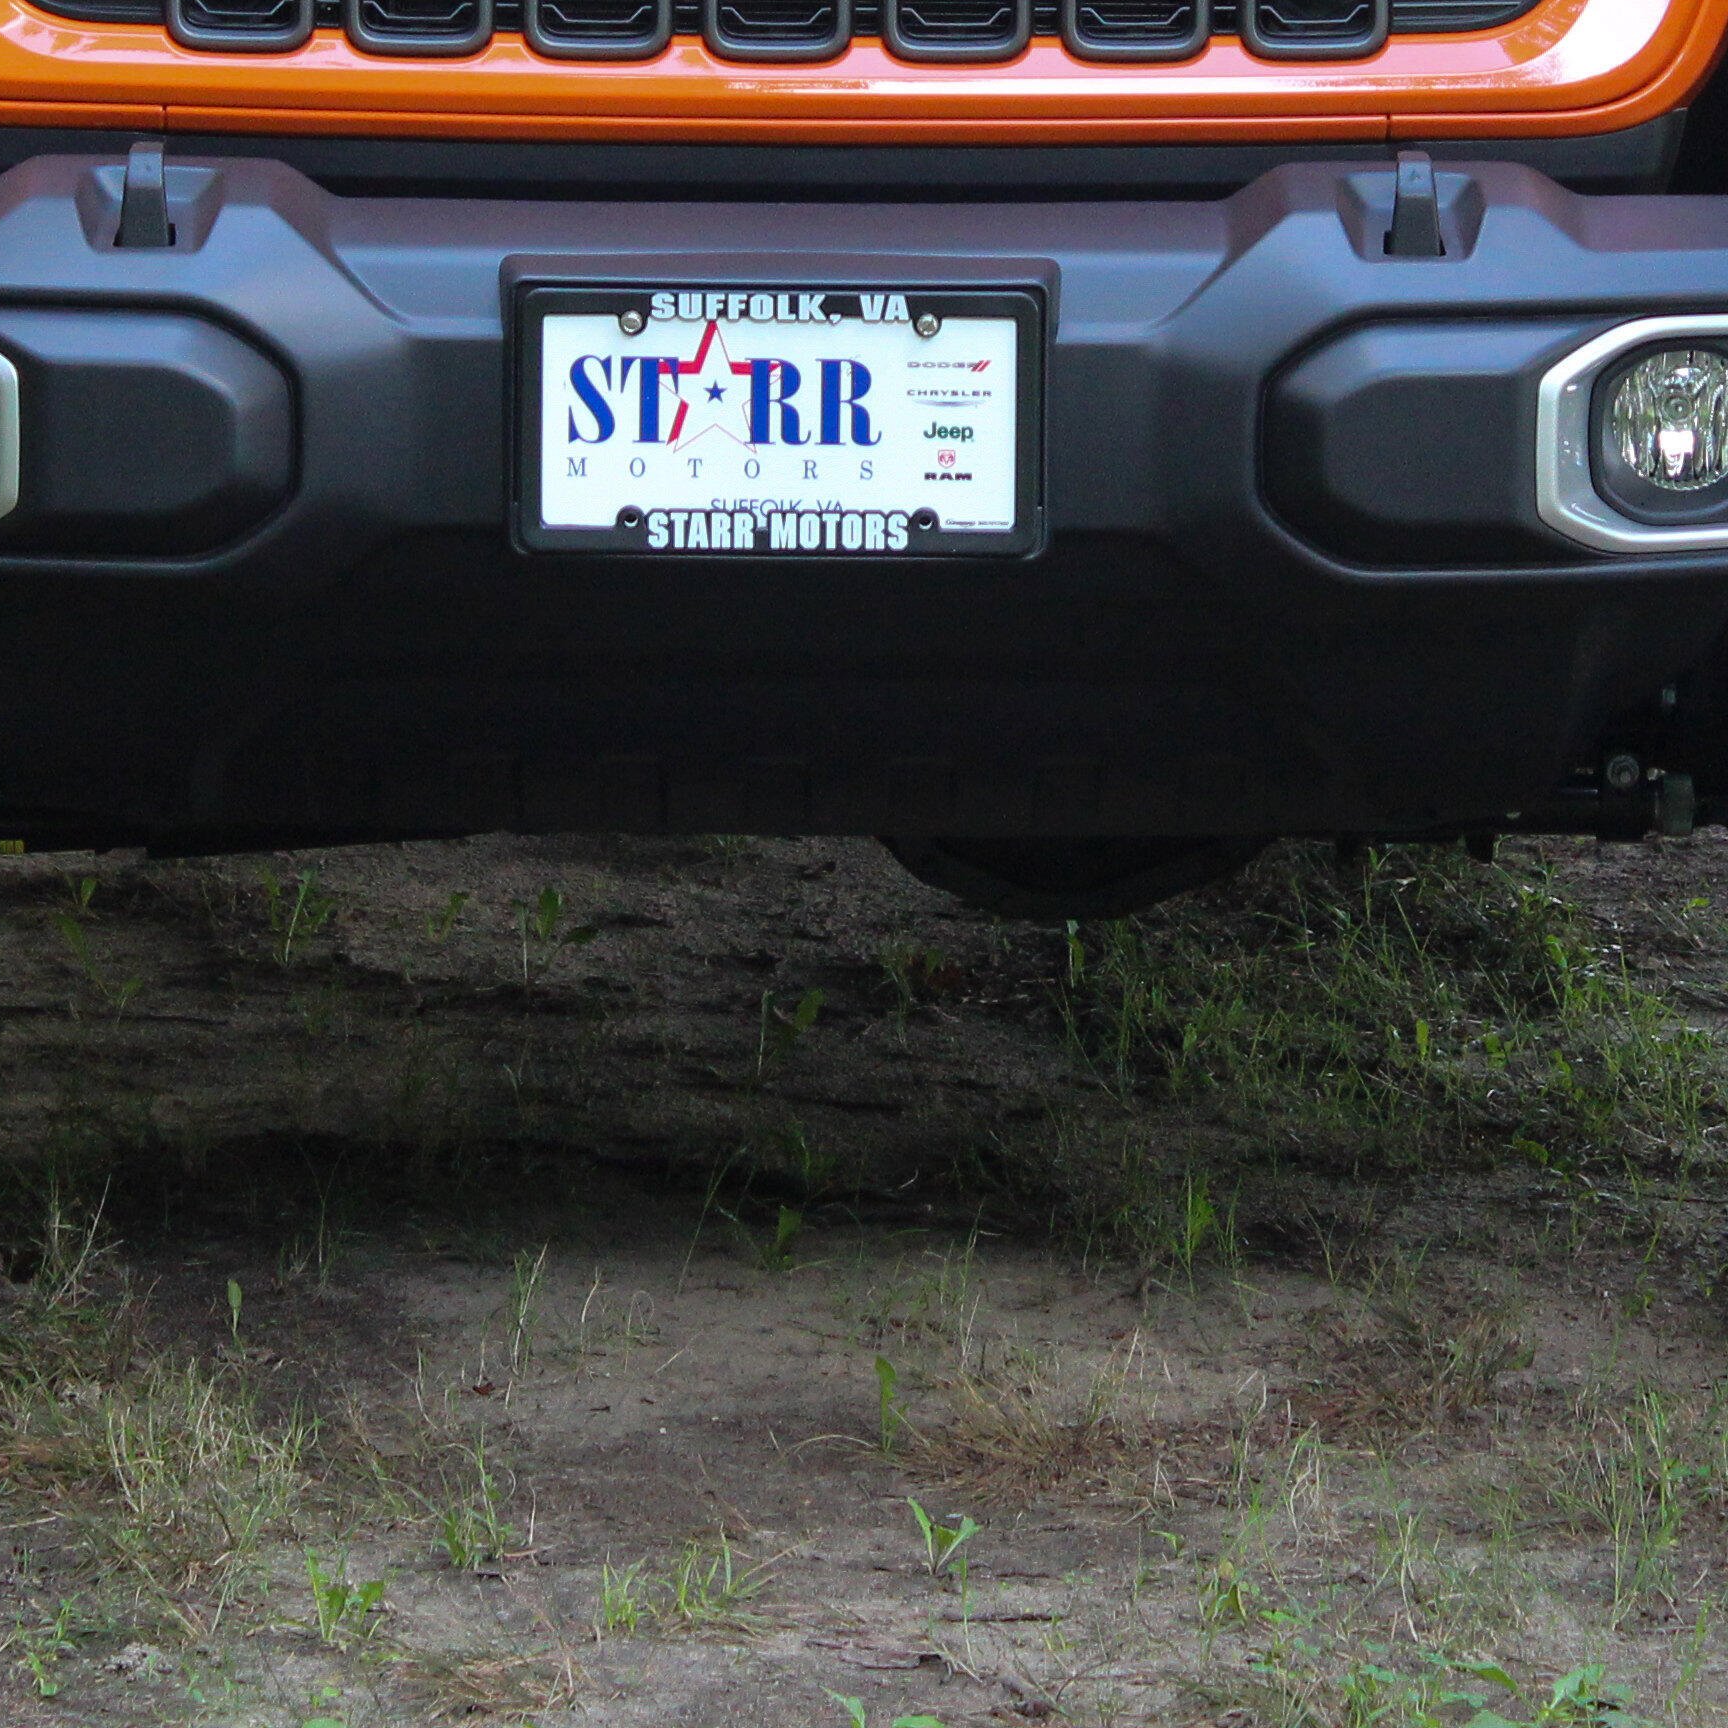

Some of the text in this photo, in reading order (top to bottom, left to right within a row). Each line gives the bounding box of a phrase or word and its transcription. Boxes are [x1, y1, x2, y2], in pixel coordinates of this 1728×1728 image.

[650, 292, 910, 325] SUFFOLK, VA
[906, 389, 993, 398] CHRYSLER
[923, 421, 975, 443] Jeep
[923, 472, 973, 481] RAM
[647, 510, 909, 551] STARR MOTORS
